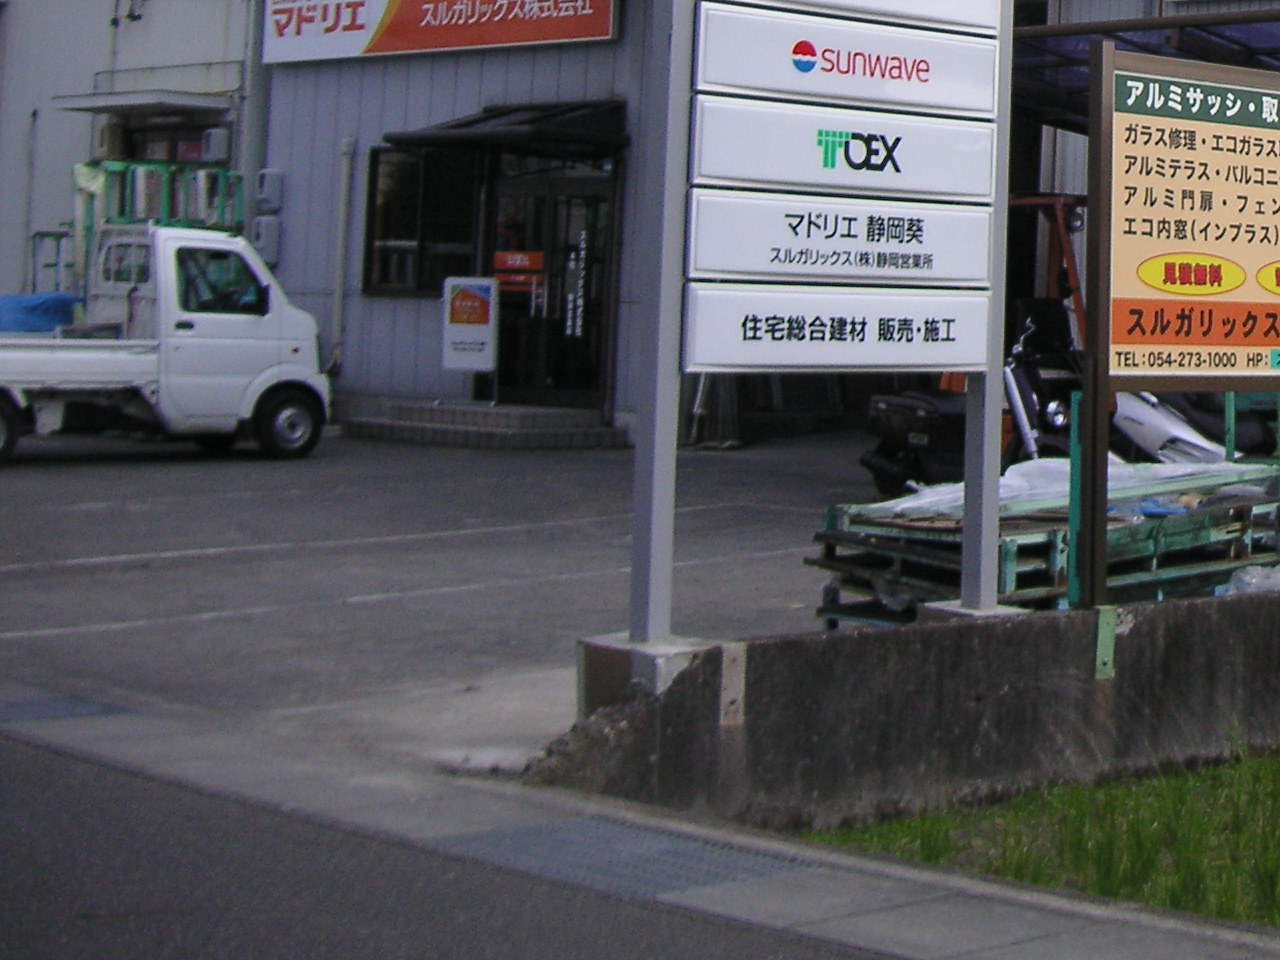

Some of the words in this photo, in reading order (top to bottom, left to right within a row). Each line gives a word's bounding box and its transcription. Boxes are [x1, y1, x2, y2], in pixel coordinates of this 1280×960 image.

[272, 1, 366, 37] マドリエ
[817, 129, 902, 173] TOEX
[785, 212, 858, 240] マドリエ
[866, 215, 925, 244] 静岡葵
[741, 314, 868, 343] 住宅総合建材
[877, 317, 956, 343] 販売・施工
